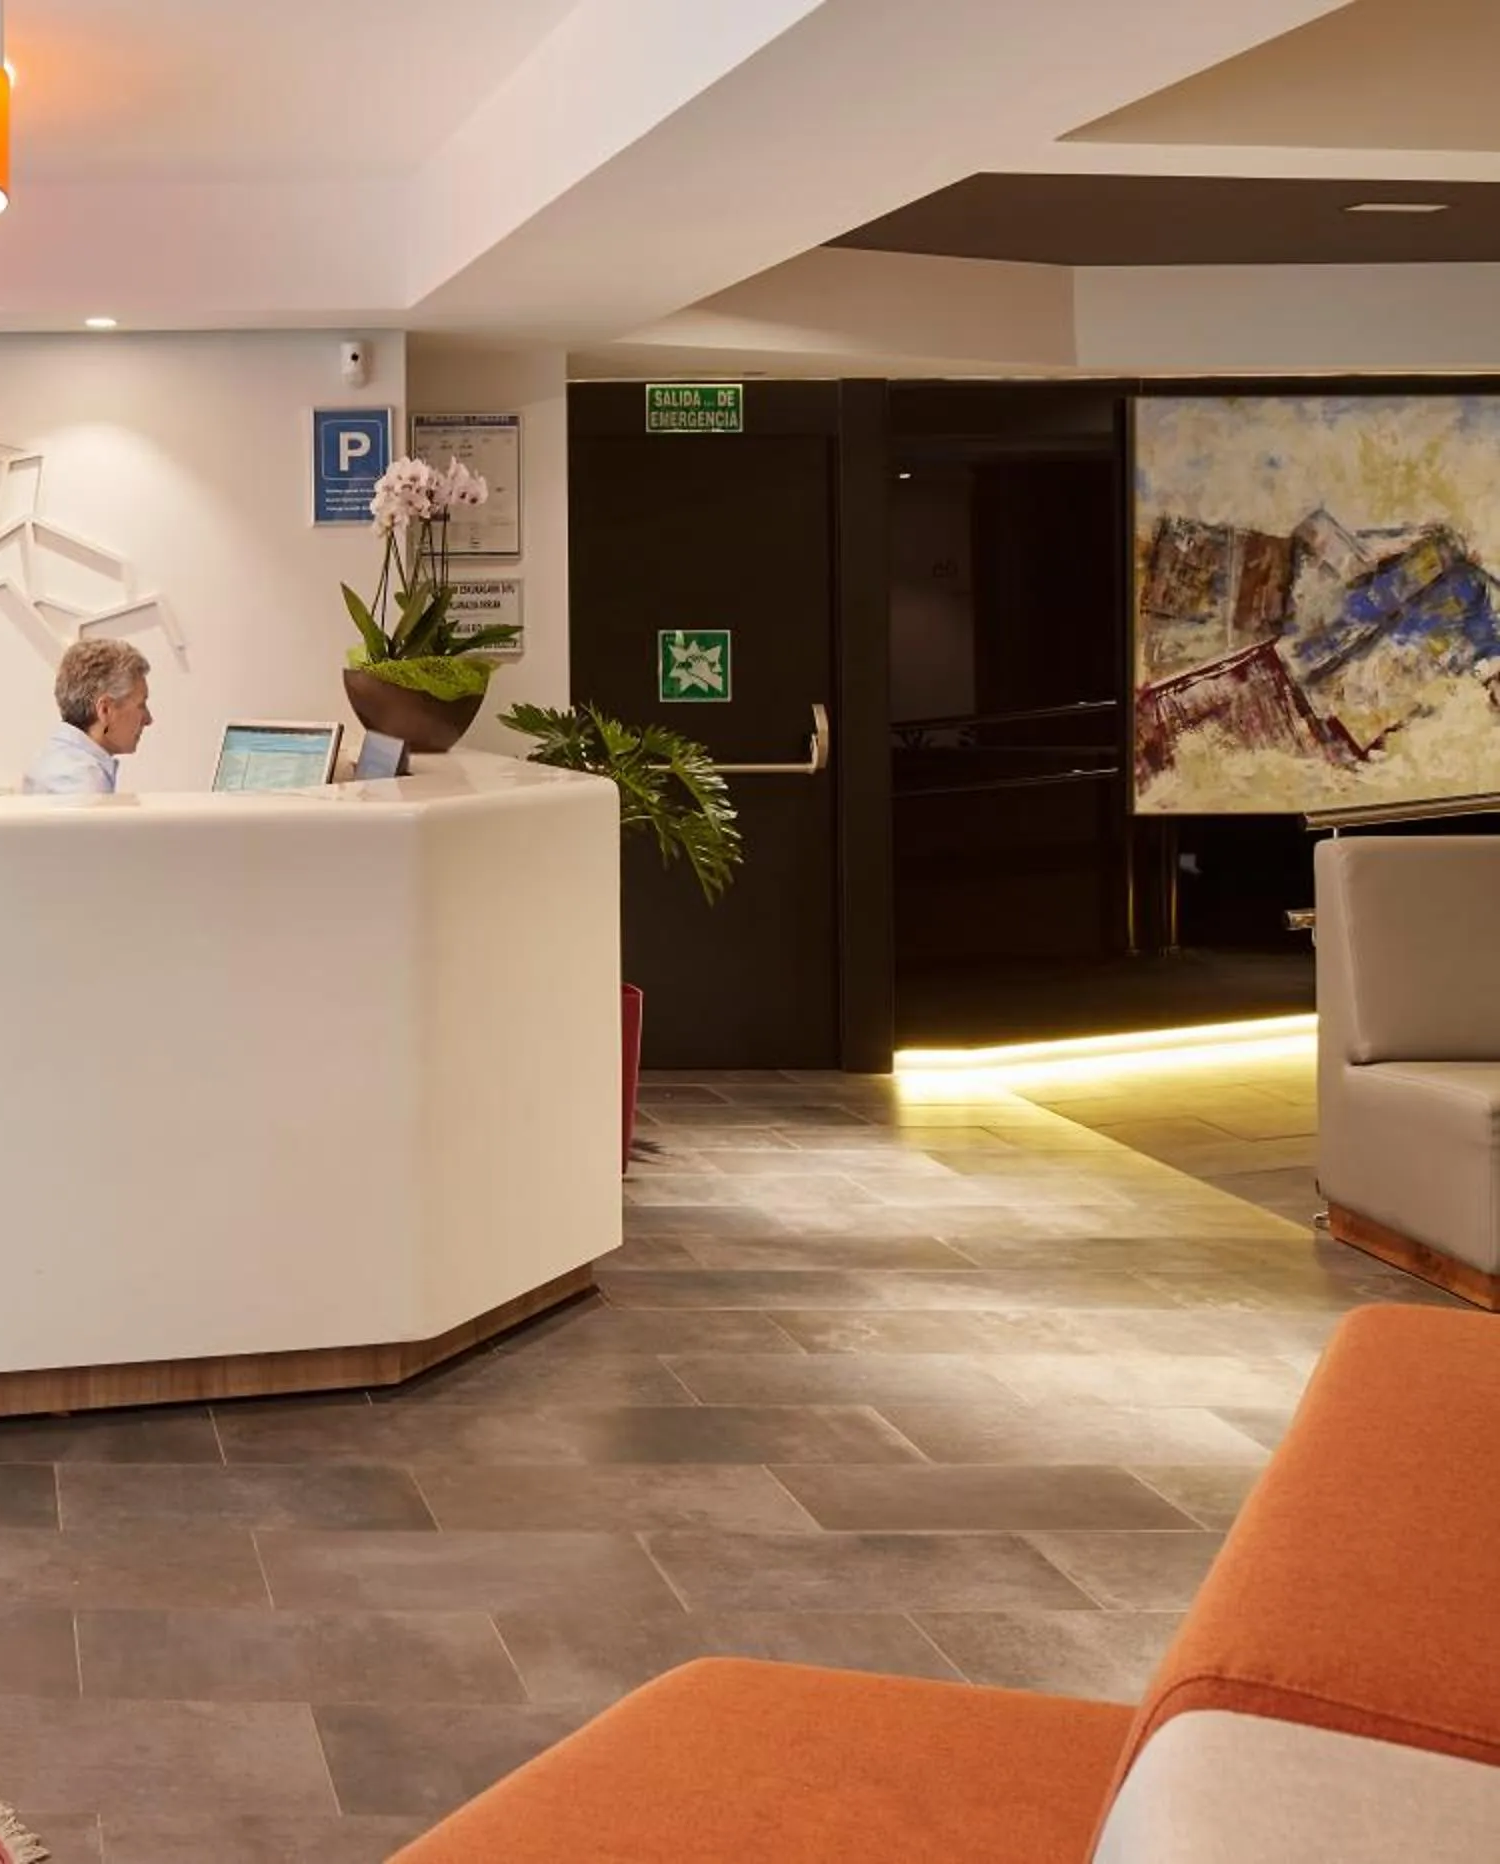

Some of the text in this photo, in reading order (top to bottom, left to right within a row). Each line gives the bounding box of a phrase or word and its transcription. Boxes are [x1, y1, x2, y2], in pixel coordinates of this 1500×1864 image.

[654, 389, 735, 408] SALIDA DE
[650, 411, 738, 428] EMERGENCIA
[339, 431, 371, 471] P
